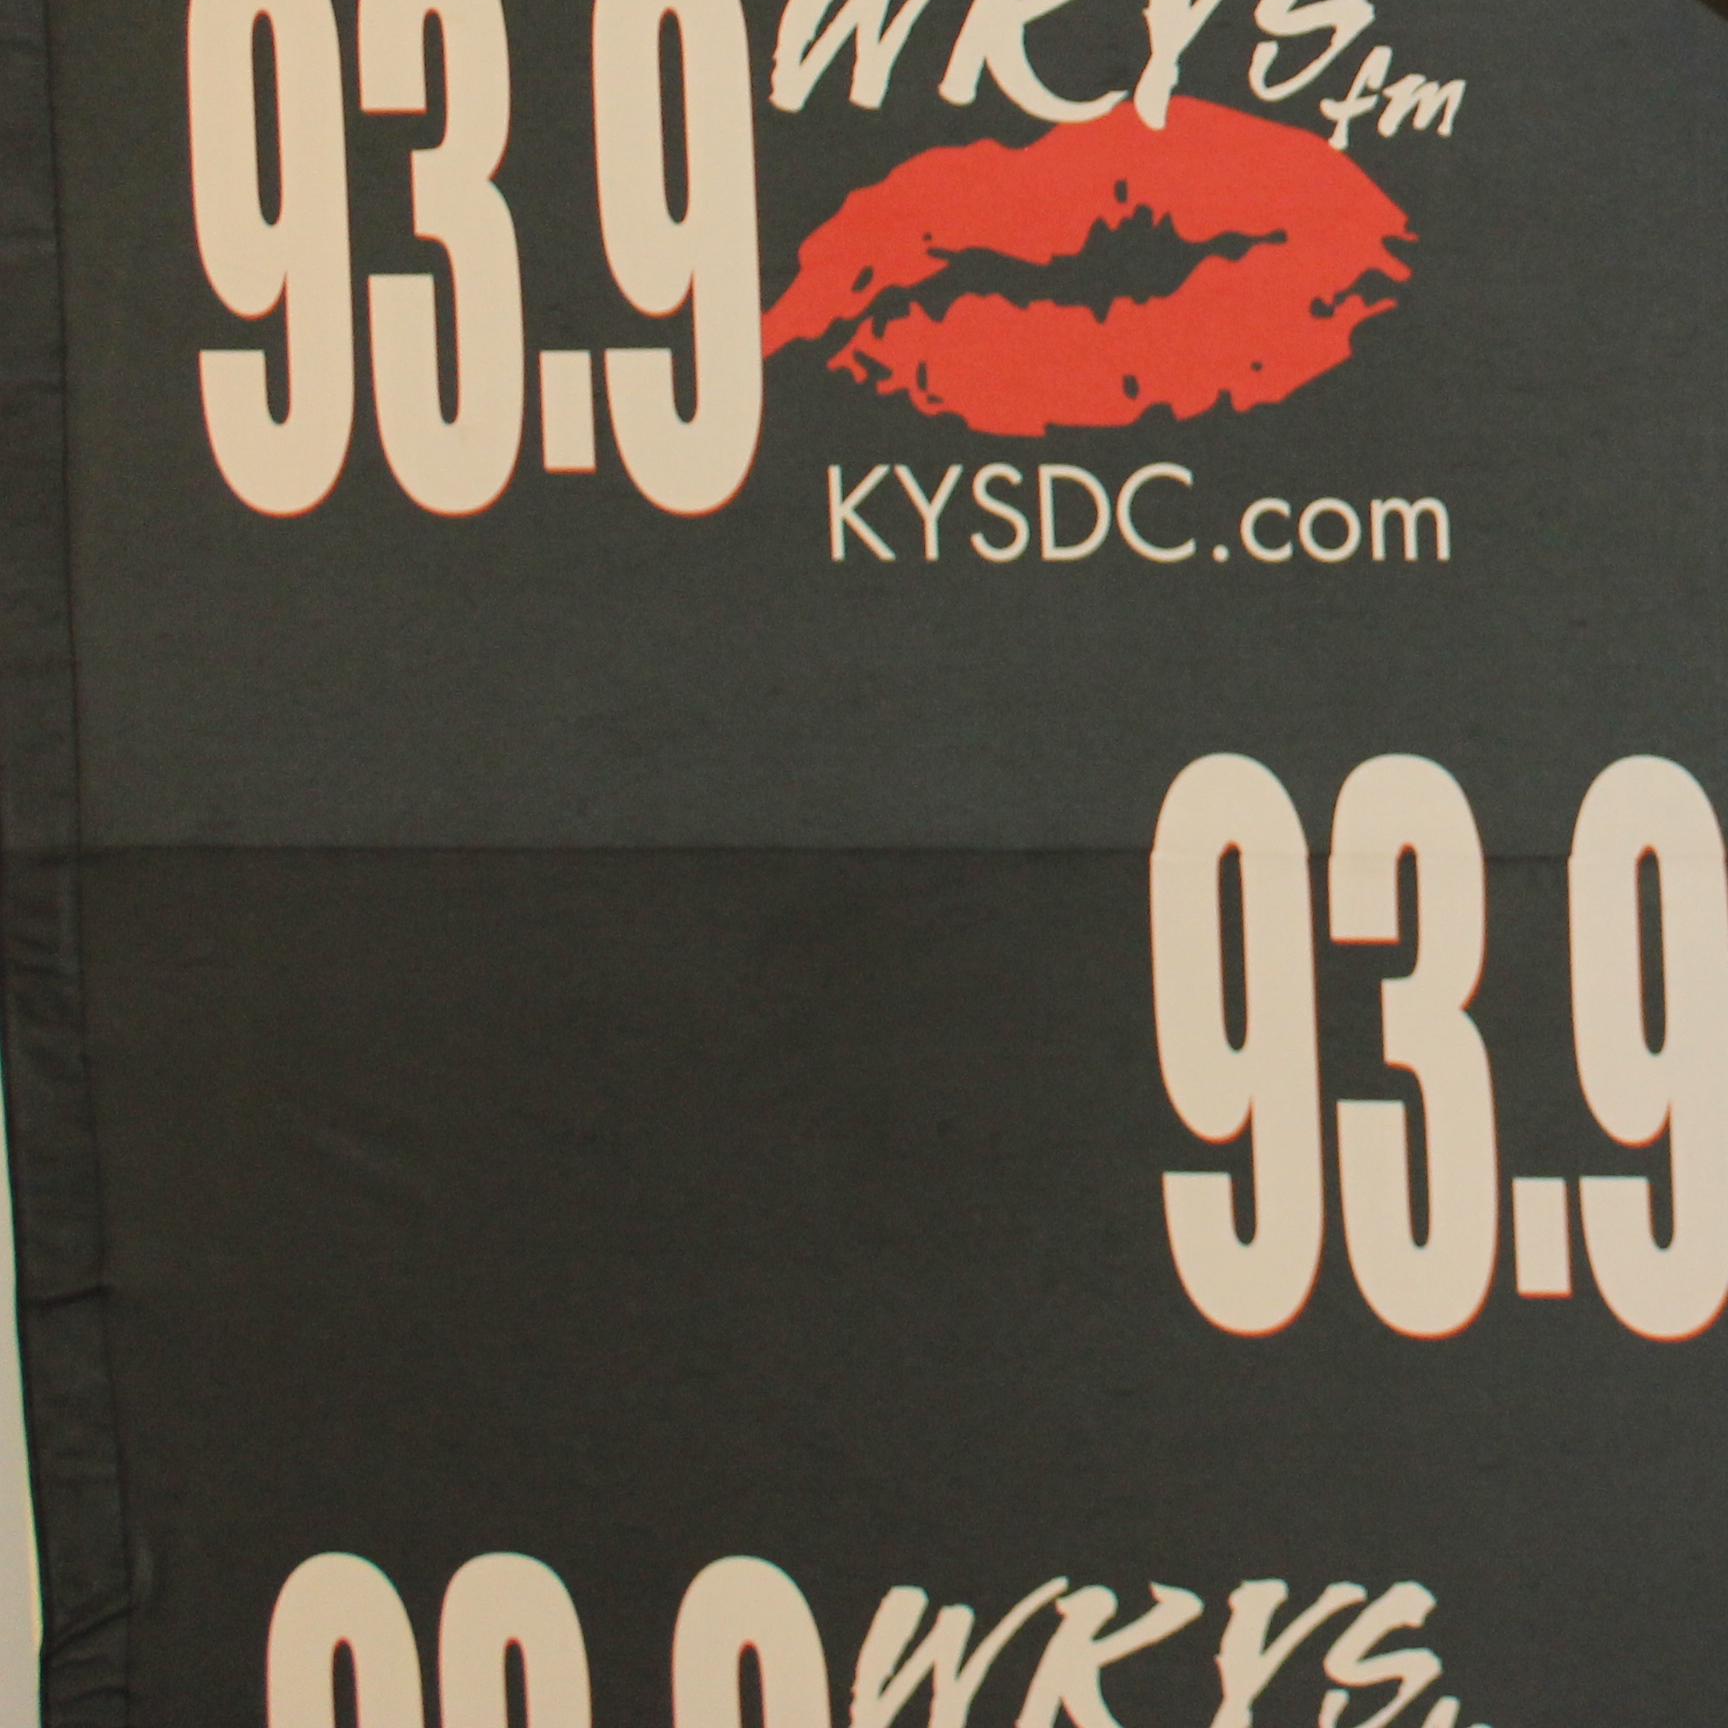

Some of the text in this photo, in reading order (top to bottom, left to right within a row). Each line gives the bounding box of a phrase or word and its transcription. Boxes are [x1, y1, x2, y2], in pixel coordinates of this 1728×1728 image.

[1320, 45, 1466, 151] fm
[828, 462, 1452, 562] KYSDC.com
[850, 1576, 1442, 1728] WKYS
